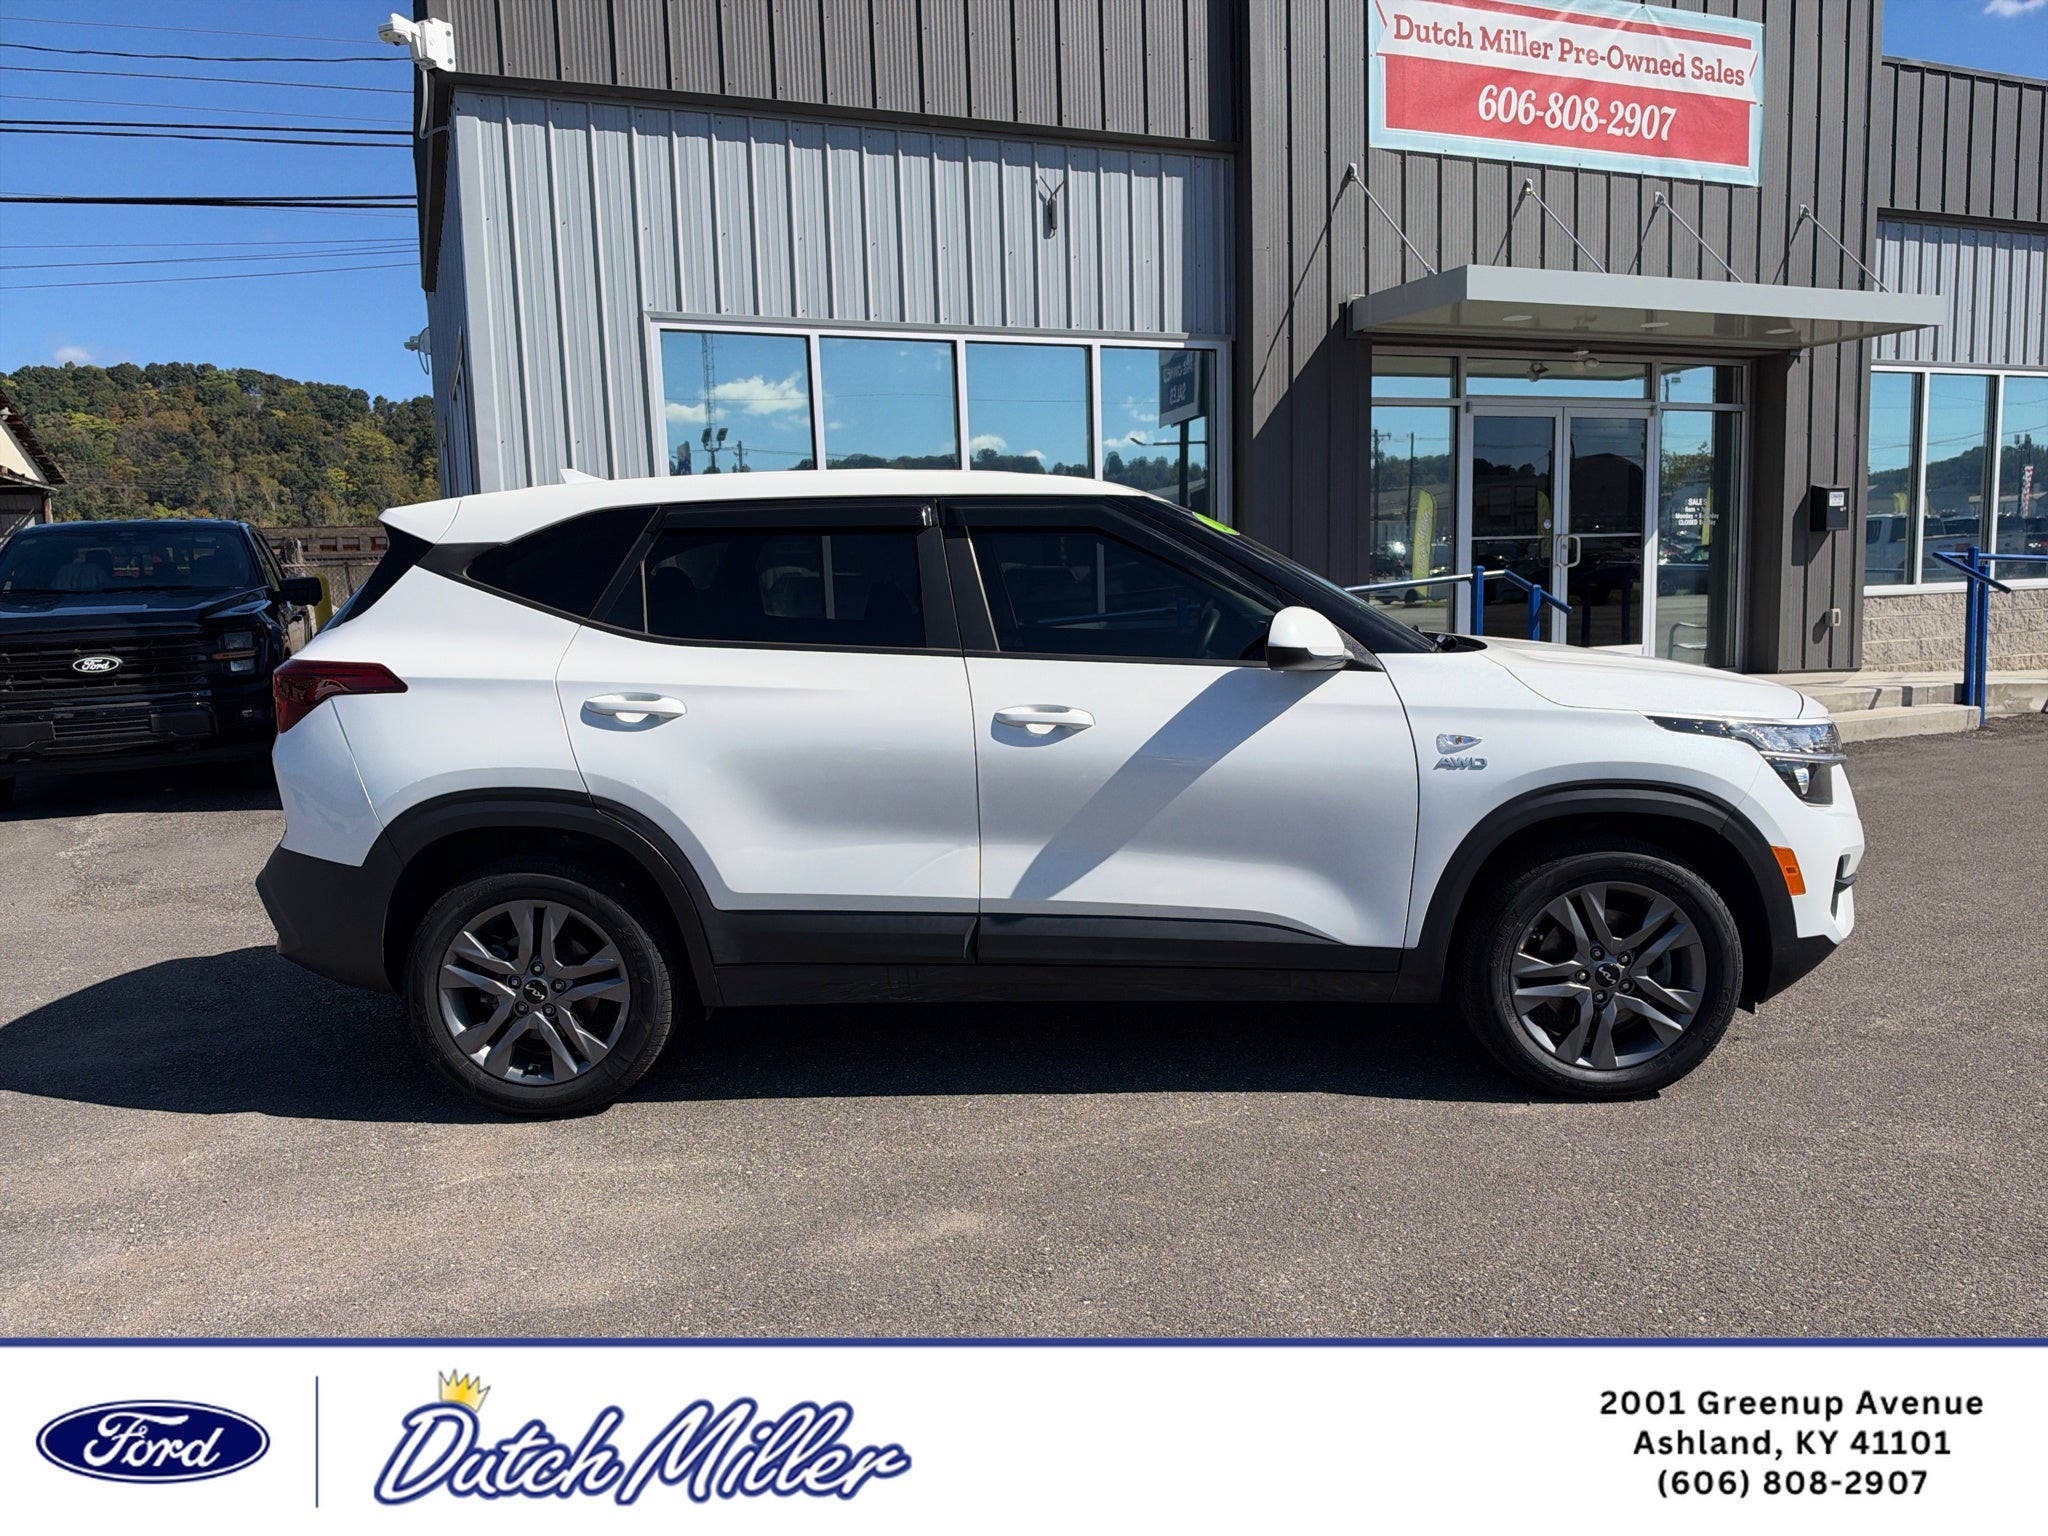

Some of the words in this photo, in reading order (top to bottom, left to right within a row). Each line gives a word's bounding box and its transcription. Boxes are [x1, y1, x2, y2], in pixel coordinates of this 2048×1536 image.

[1394, 14, 1474, 49] Dutch
[1480, 26, 1553, 59] Miller
[1558, 37, 1685, 78] Pre-Owned
[1691, 56, 1744, 86] Sales
[1478, 84, 1677, 141] 606-808-2907
[82, 659, 110, 670] Ford
[1432, 757, 1488, 770] AWD
